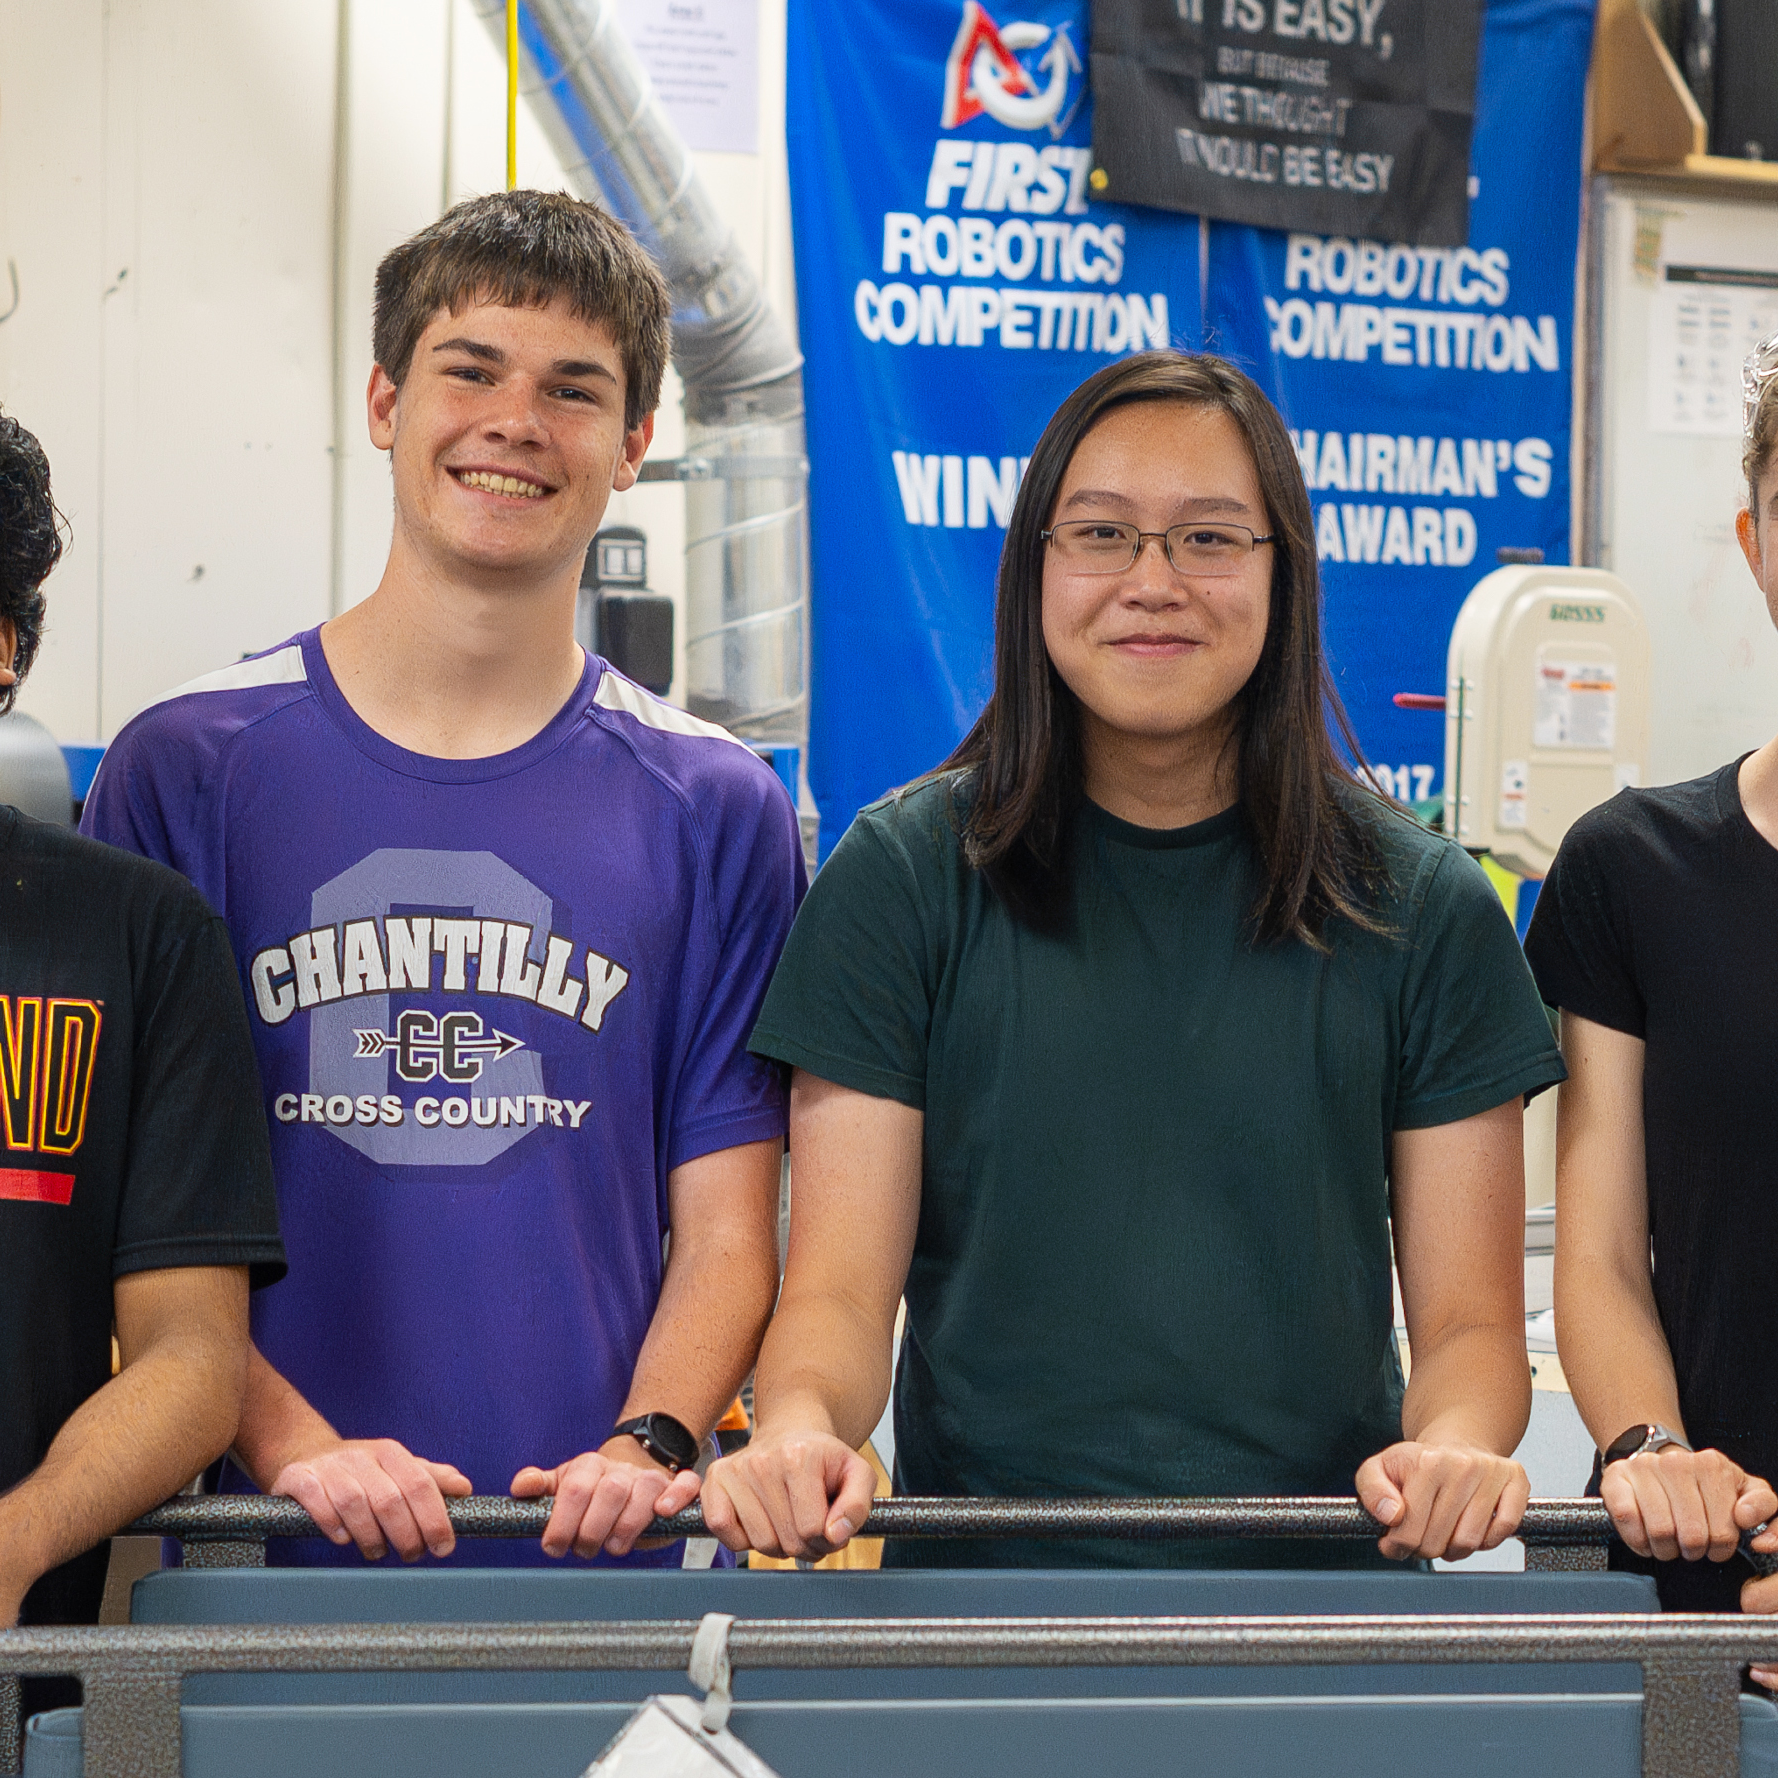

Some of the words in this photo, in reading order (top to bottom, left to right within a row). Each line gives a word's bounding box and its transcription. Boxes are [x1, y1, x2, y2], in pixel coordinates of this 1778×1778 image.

[882, 211, 1125, 283] ROBOTICS
[1284, 235, 1510, 305] ROBOTICS
[855, 279, 1168, 354] COMPETITION
[893, 450, 1034, 528] WIN
[1287, 429, 1554, 498] HAIRMAN'S
[1316, 504, 1479, 566] AWARD
[250, 915, 631, 1036] CHANTILLY
[274, 1093, 404, 1126] CROSS
[414, 1095, 592, 1129] COUNTRY
